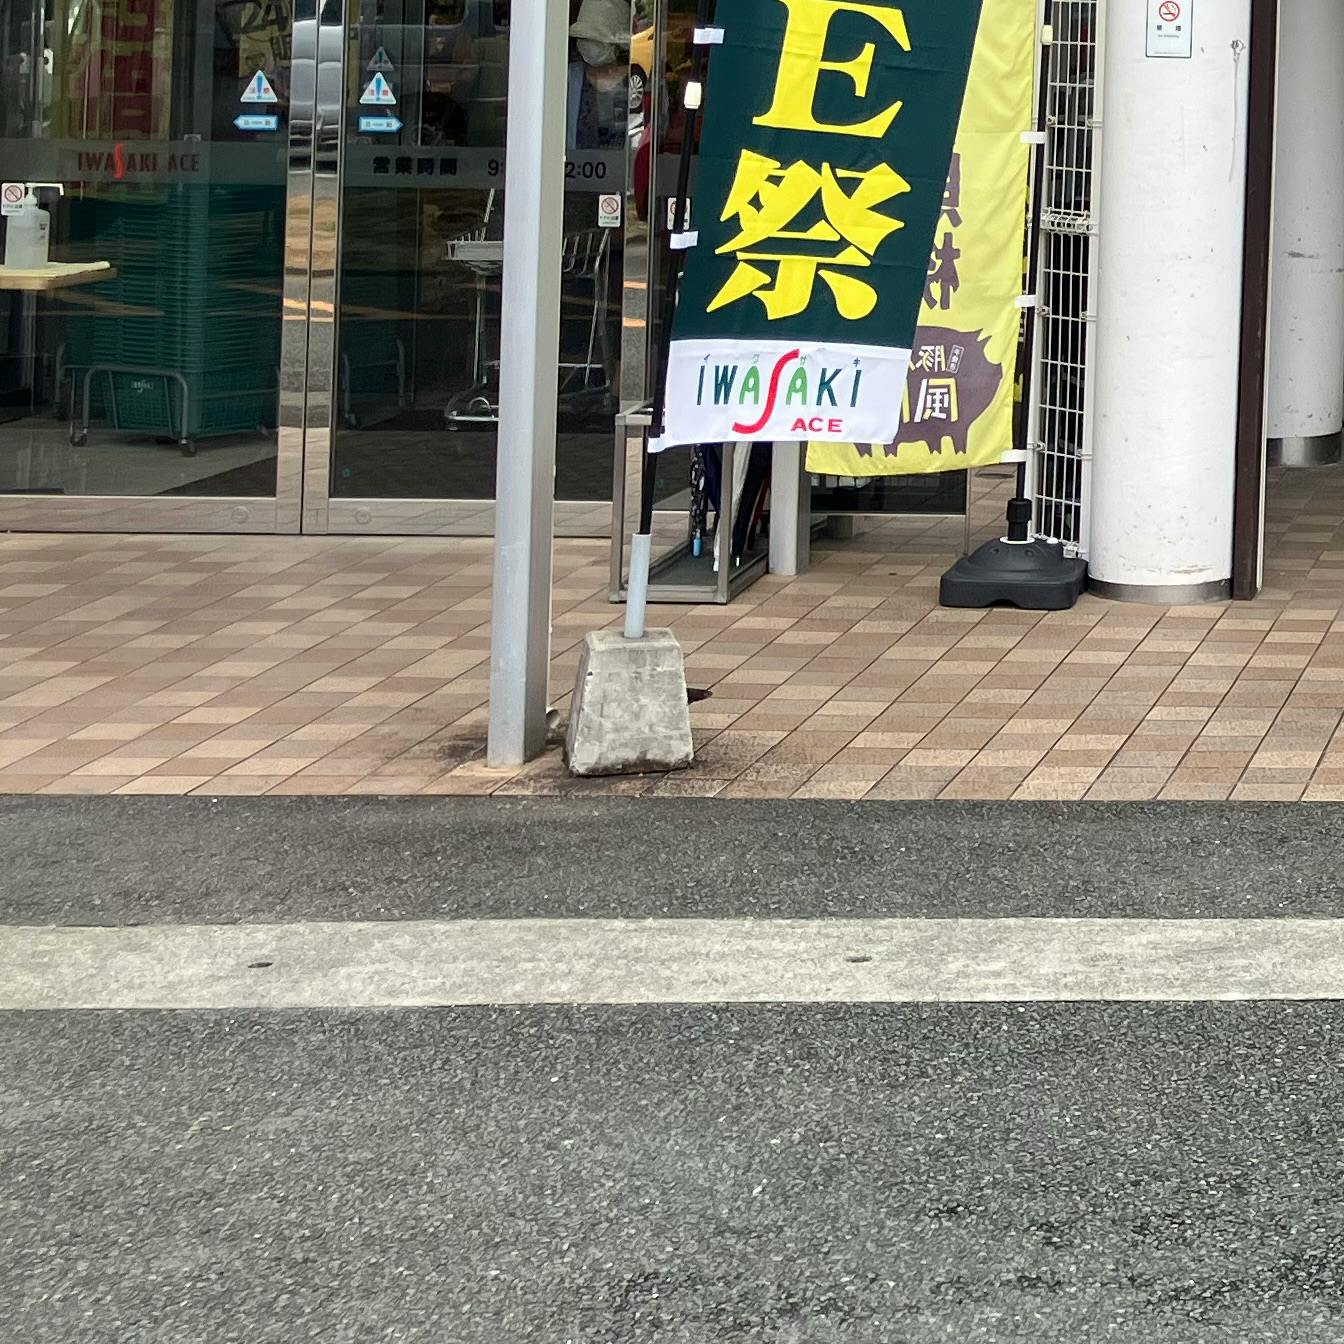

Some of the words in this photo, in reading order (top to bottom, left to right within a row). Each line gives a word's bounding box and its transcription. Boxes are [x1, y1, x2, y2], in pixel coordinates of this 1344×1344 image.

[78, 143, 158, 179] IWASAKI
[168, 154, 200, 172] ACE
[372, 156, 457, 176] 営業時間
[564, 161, 607, 178] 2:00
[697, 348, 862, 434] IWASAKI
[790, 417, 843, 433] ACE
